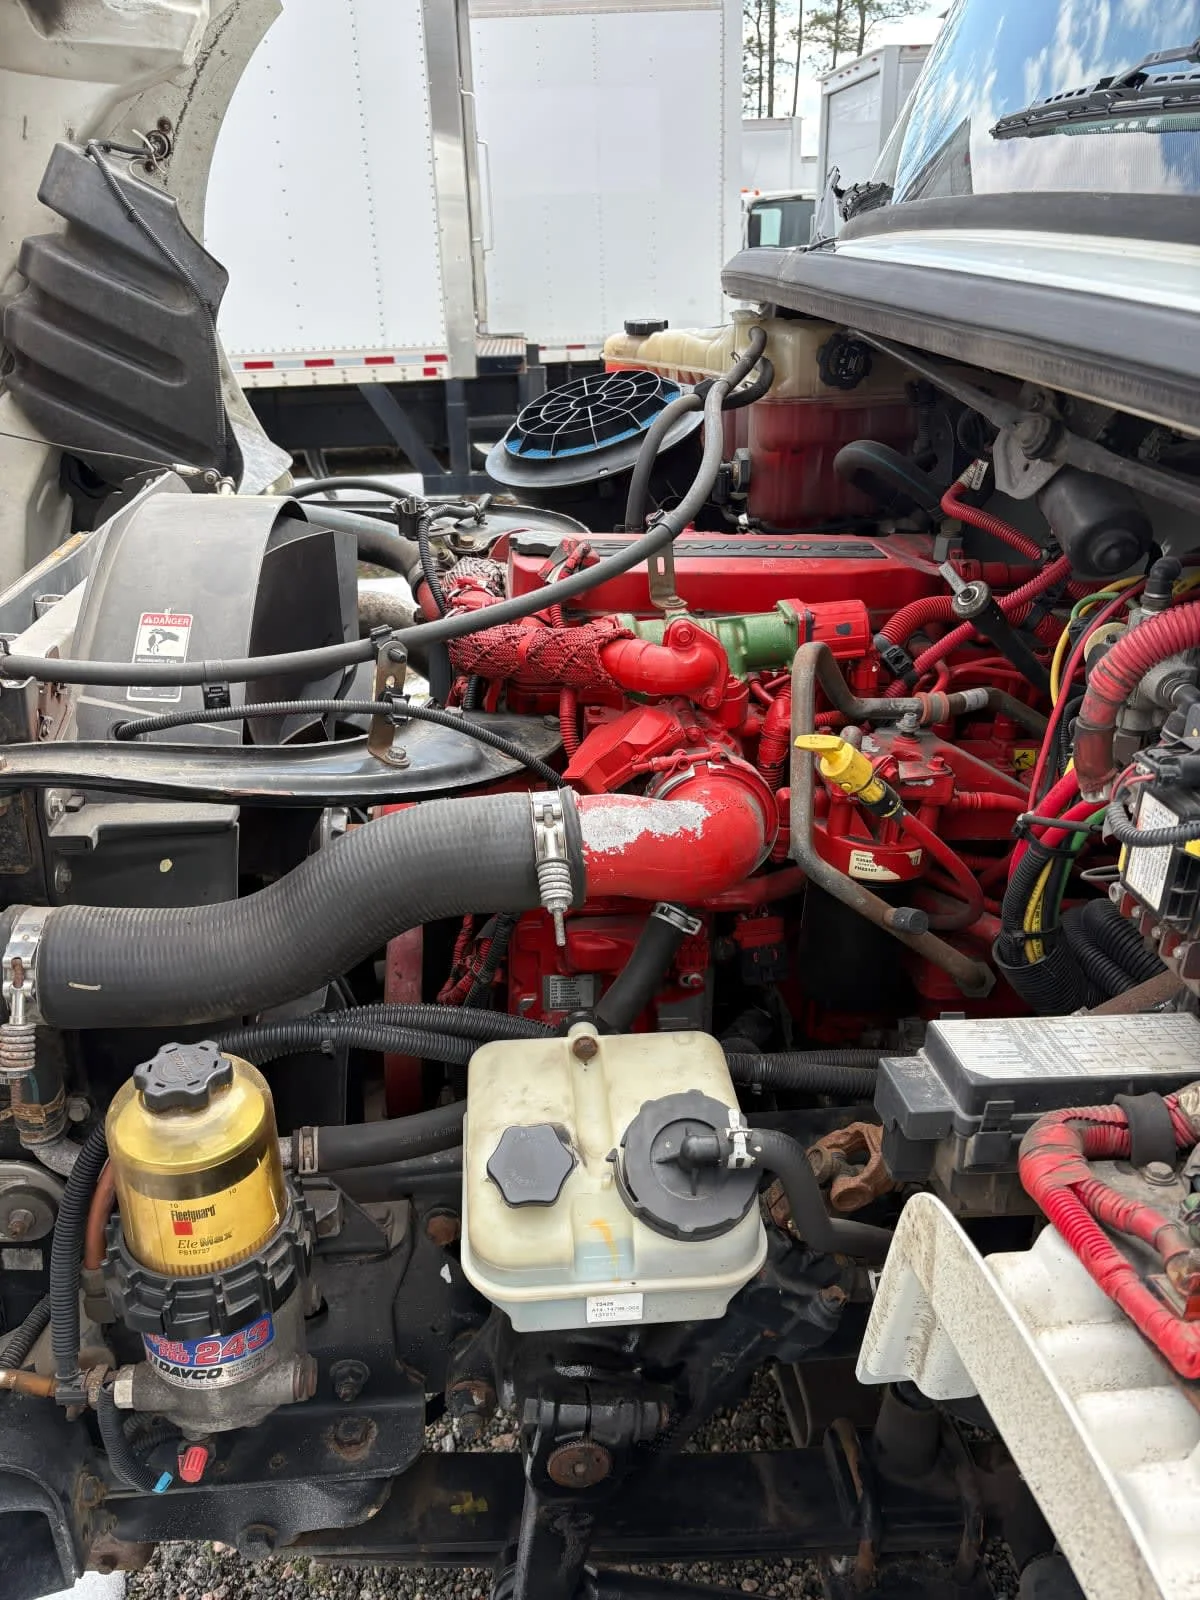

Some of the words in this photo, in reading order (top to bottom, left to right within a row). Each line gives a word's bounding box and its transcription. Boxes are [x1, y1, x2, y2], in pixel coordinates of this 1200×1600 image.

[153, 617, 190, 625] DANGER
[170, 1204, 216, 1223] Fleetguard
[194, 1317, 271, 1365] 243
[158, 1360, 223, 1380] DAVCO
